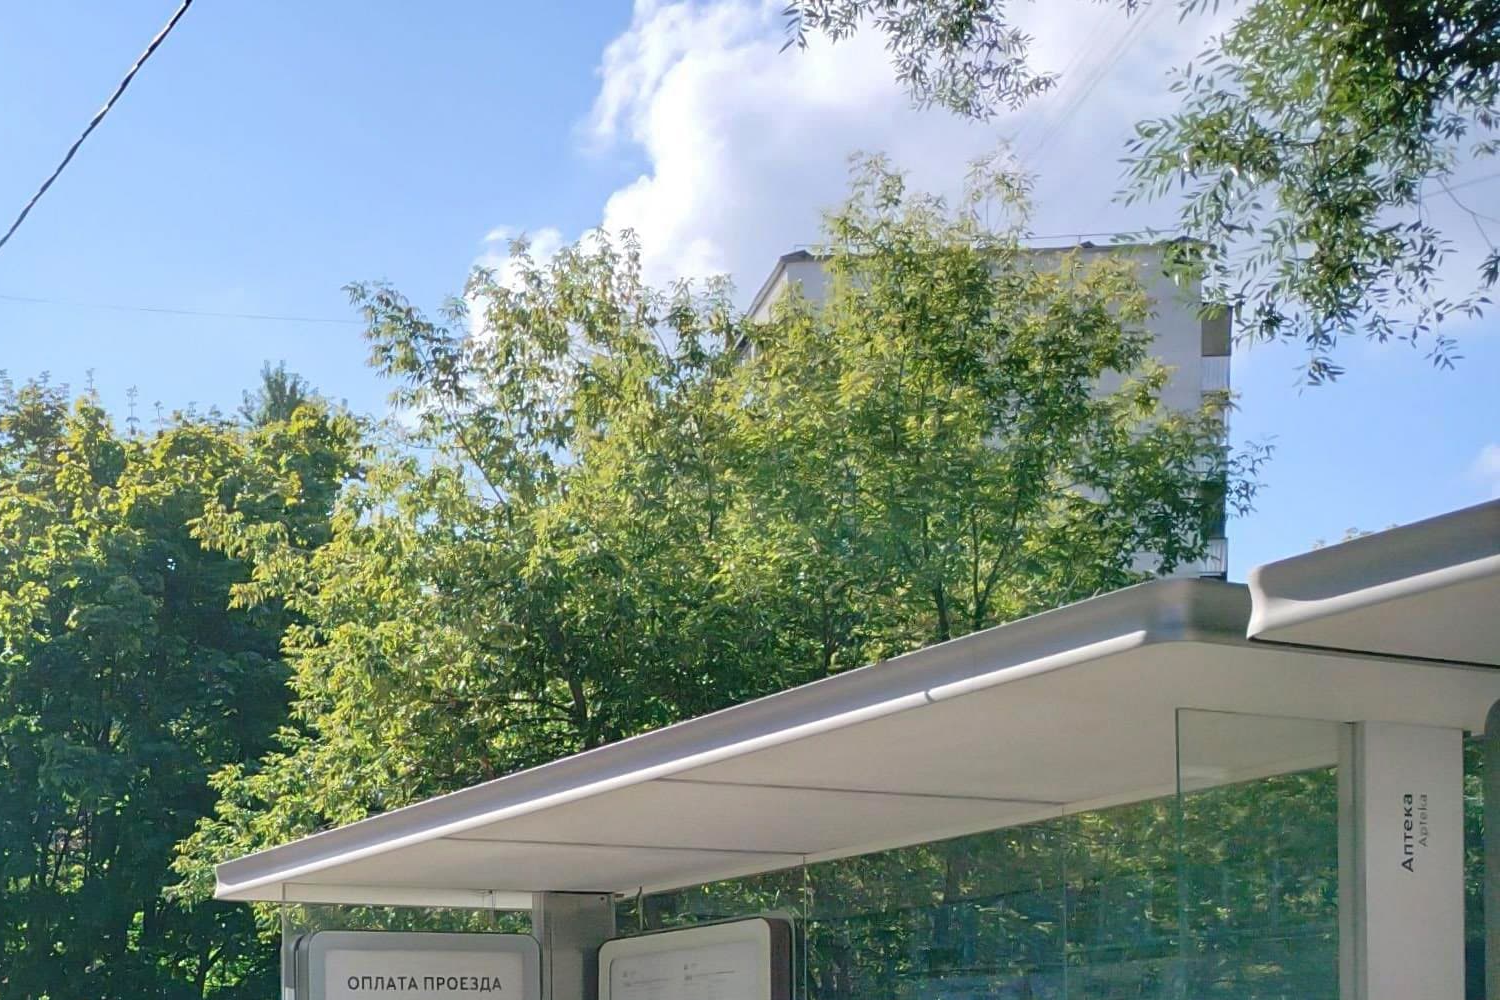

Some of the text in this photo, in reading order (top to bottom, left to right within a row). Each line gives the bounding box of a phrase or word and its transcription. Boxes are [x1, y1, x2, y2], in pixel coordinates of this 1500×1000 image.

[1401, 793, 1414, 873] Аптека
[1417, 793, 1428, 847] Apteka
[347, 975, 503, 993] ОПЛАТА ПРОЕЗДА
